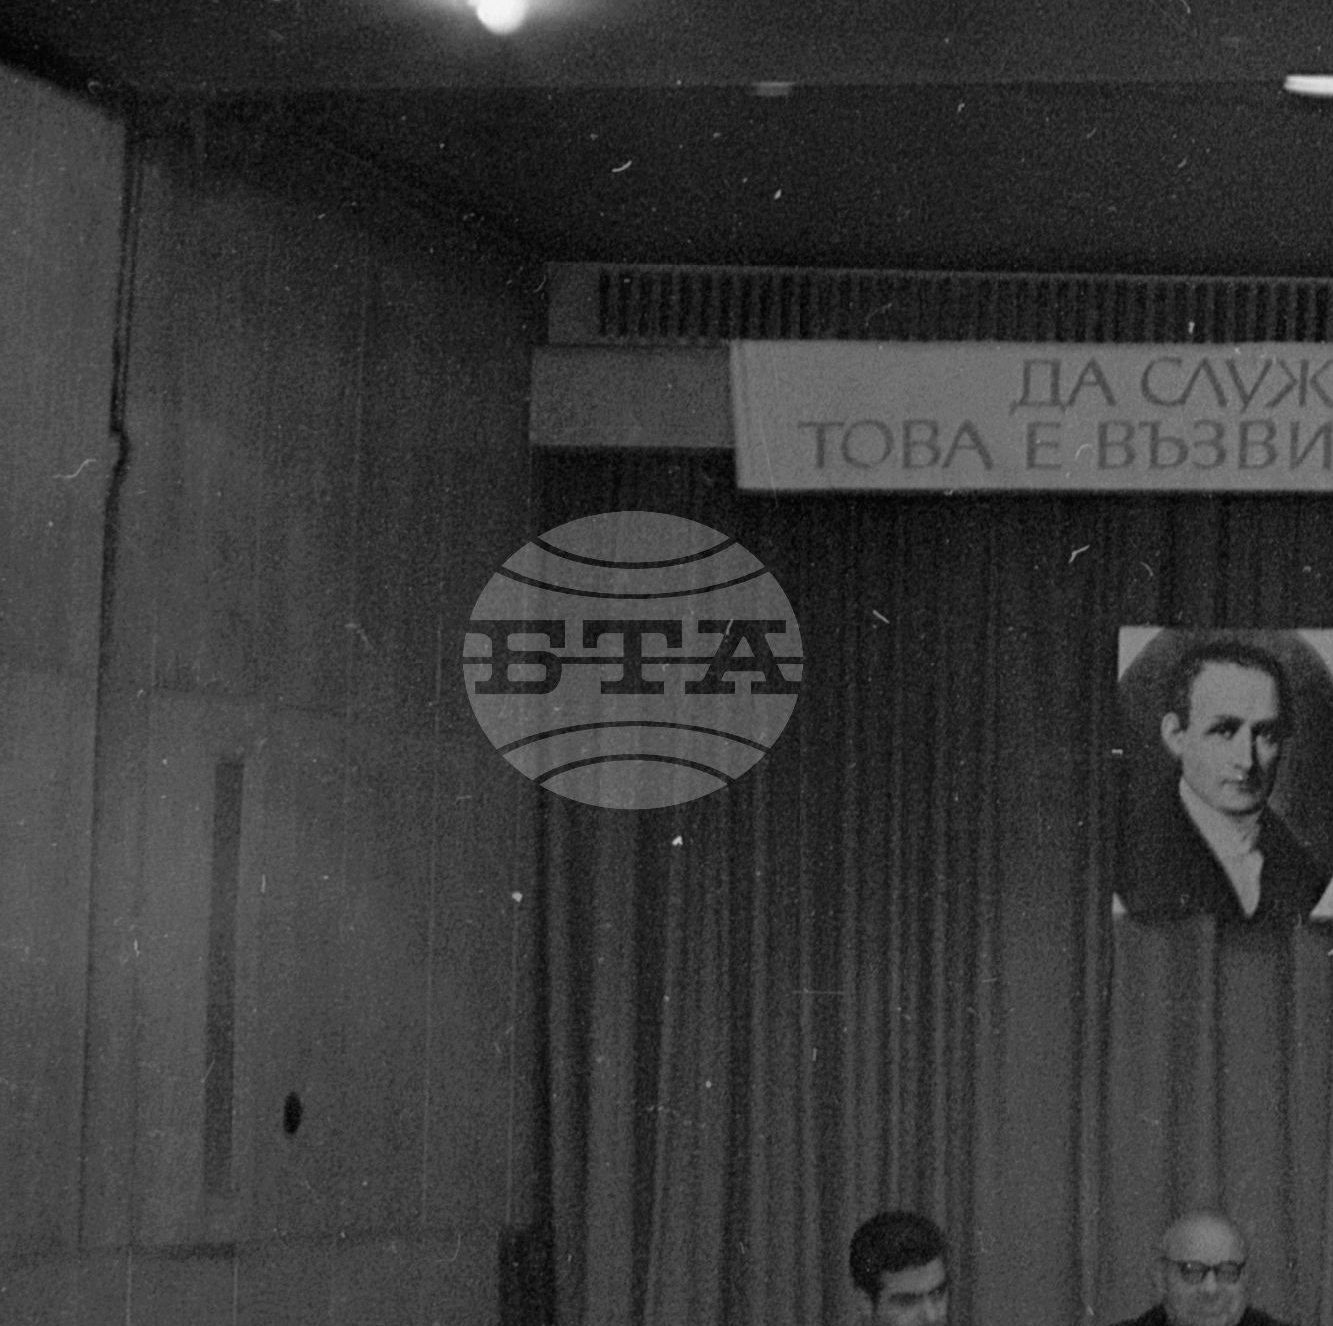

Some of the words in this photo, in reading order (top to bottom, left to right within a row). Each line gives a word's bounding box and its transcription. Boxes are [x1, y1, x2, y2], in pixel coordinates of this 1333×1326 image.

[1009, 357, 1118, 416] ДА
[799, 419, 995, 470] ТОВА
[1025, 421, 1062, 470] Е
